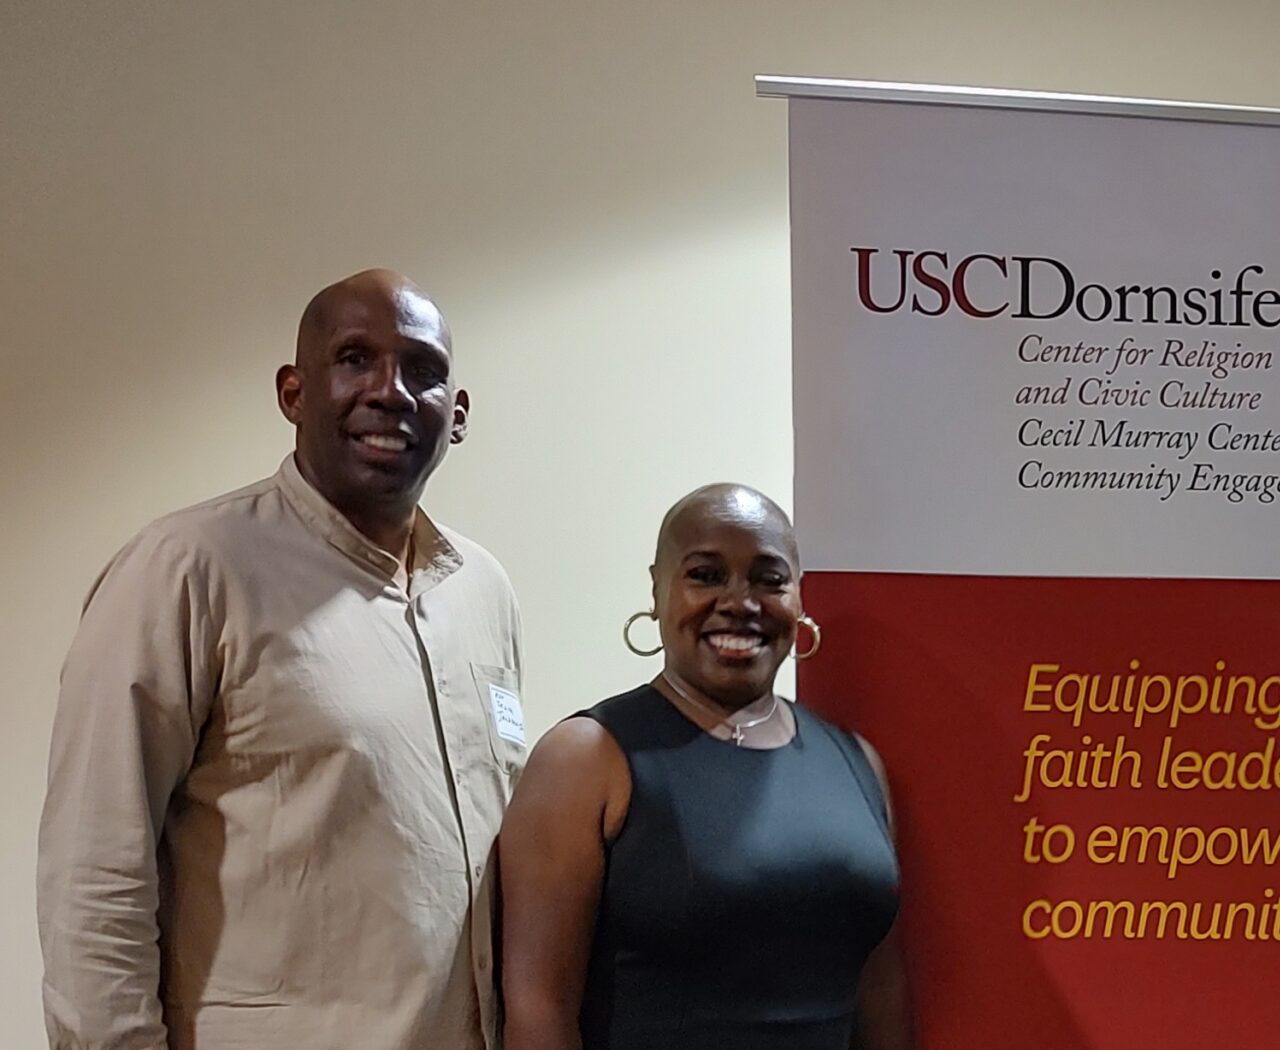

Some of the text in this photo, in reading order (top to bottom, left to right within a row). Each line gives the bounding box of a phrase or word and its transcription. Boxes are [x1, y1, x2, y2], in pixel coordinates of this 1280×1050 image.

[1017, 334, 1273, 378] Center for Religion
[1015, 377, 1262, 411] and Civic Culture
[1017, 418, 1084, 448] Cecil
[1088, 420, 1199, 458] Murray
[1017, 460, 1180, 500] Community
[1013, 735, 1141, 802] faith
[1022, 816, 1076, 864] to
